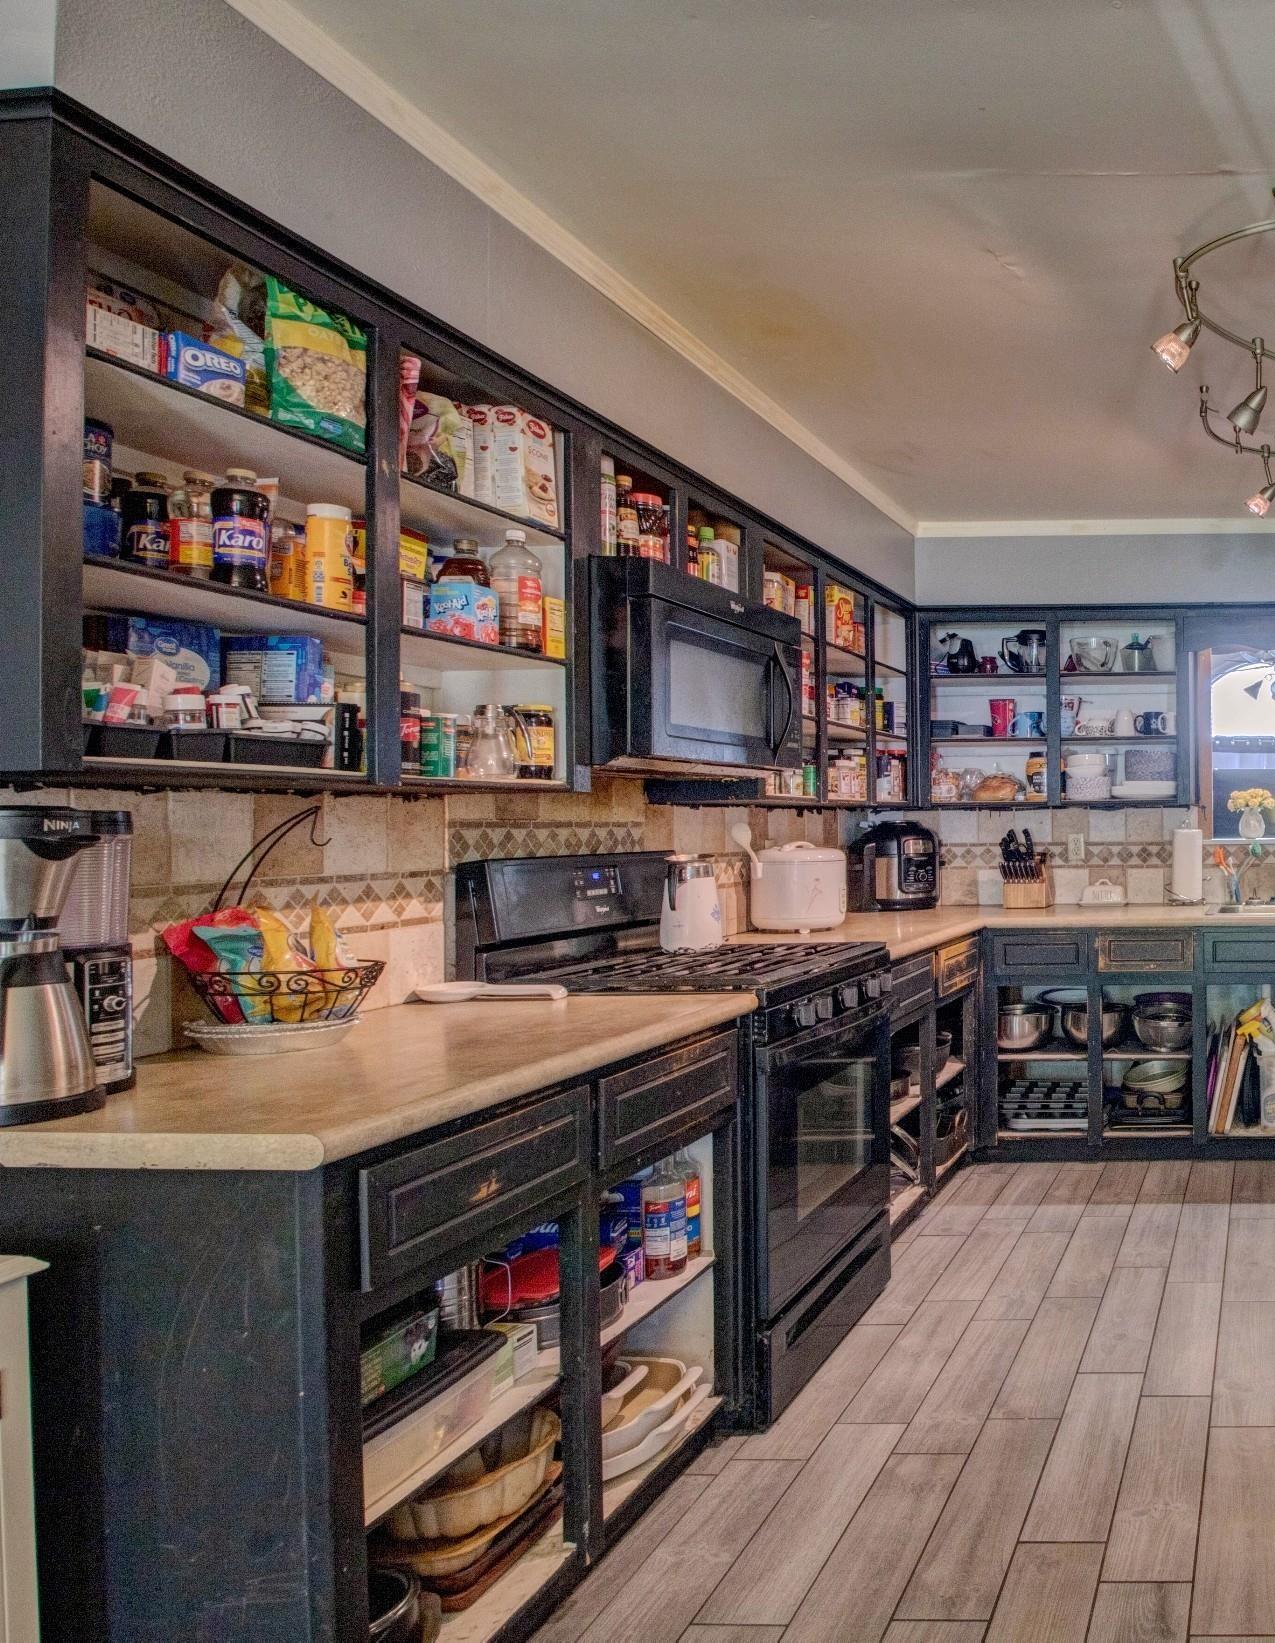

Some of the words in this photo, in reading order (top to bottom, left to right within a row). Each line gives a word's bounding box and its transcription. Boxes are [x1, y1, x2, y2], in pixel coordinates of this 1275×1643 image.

[183, 346, 244, 376] OREO
[138, 532, 170, 551] Kar
[218, 529, 265, 550] Karo
[434, 594, 468, 614] Kool-Aid
[43, 817, 81, 833] NINJA
